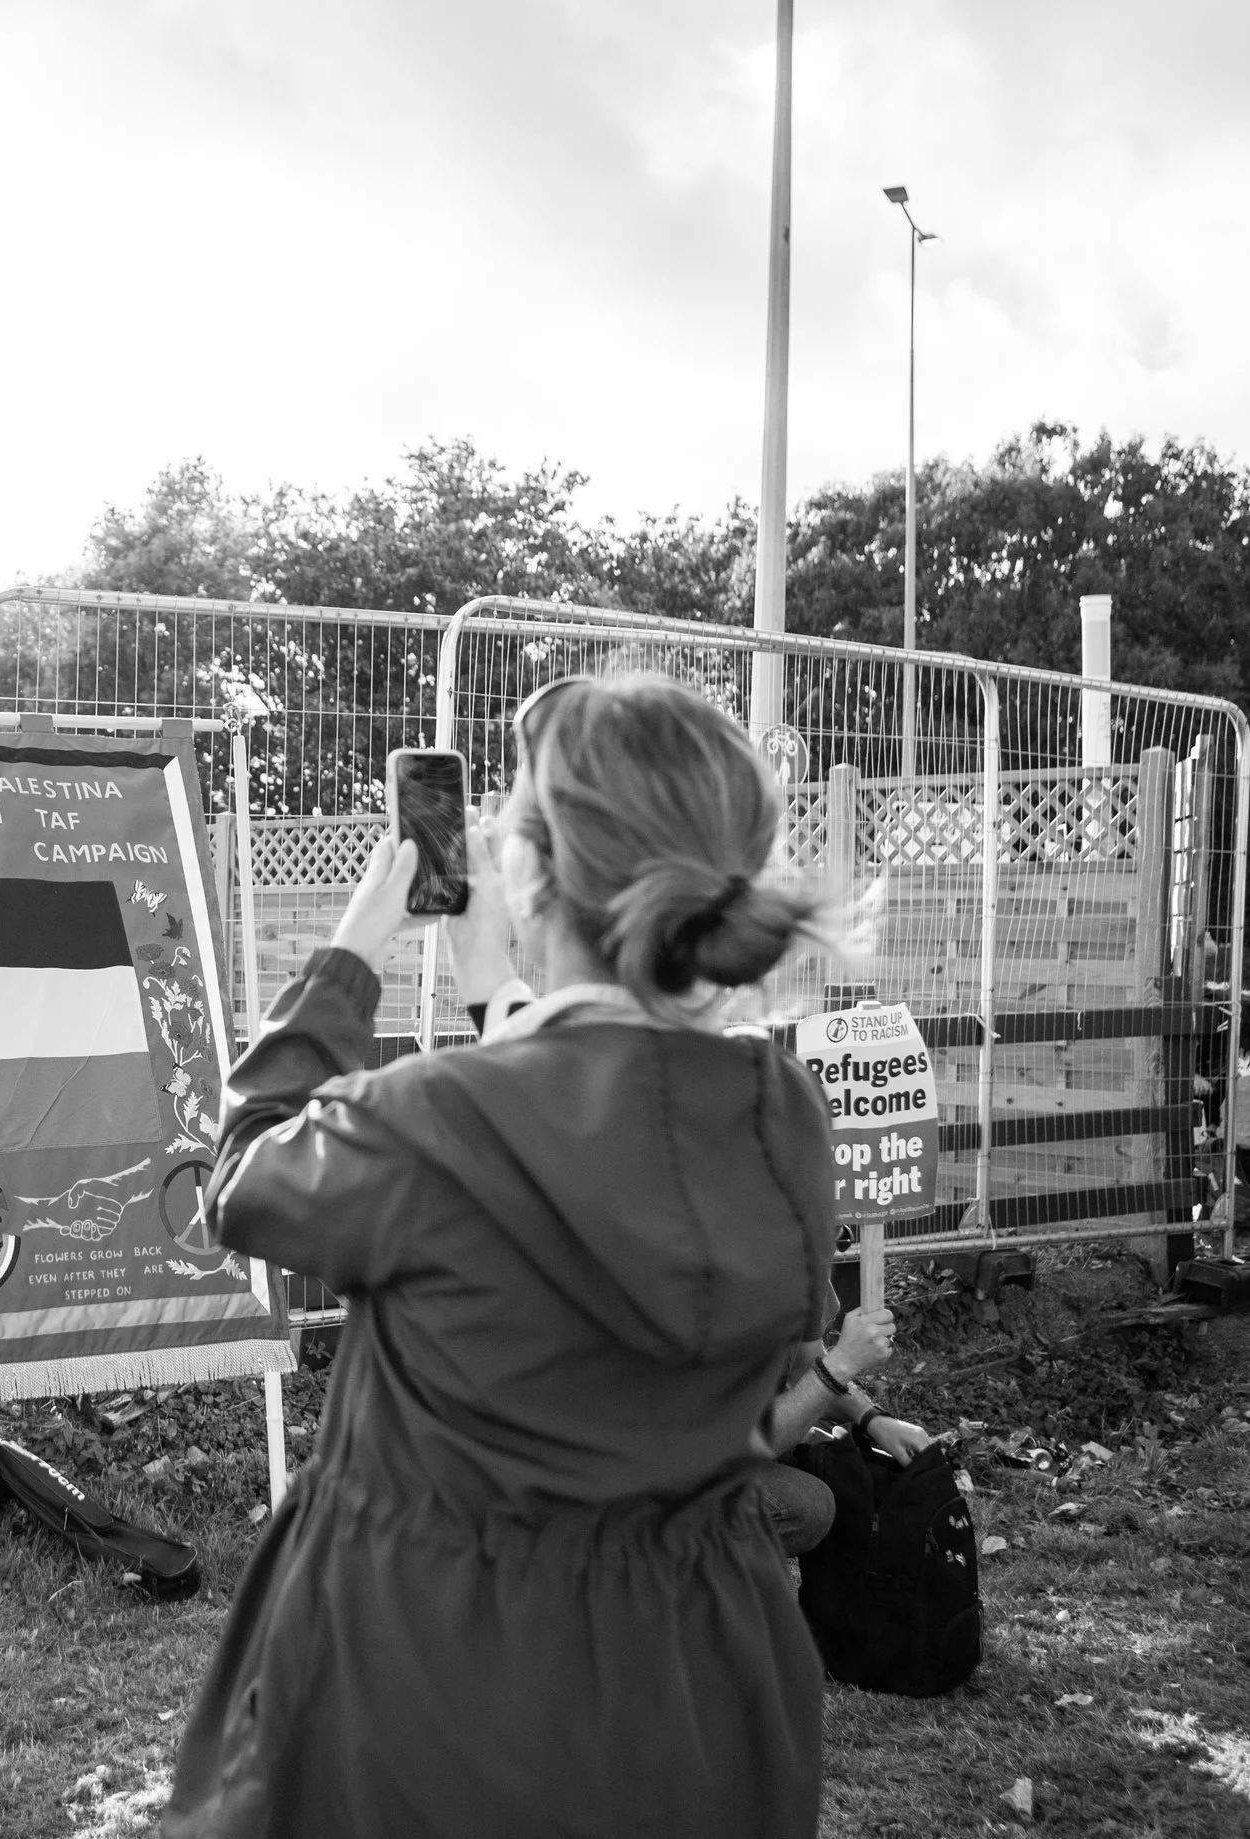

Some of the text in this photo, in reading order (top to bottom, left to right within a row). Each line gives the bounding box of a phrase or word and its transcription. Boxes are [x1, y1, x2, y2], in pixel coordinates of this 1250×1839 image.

[34, 808, 80, 830] TAF
[33, 842, 168, 864] CAMPAIGN
[851, 1012, 903, 1028] STAND UP
[852, 1024, 909, 1042] TO RACISM
[806, 1051, 928, 1088] Refugees
[829, 1088, 926, 1118] elcome
[880, 1132, 923, 1163] the
[854, 1165, 922, 1206] right
[35, 1246, 162, 1264] FLOWERS GROW BACK
[28, 1264, 164, 1285] EVEN AFTER THEY ARE
[65, 1286, 132, 1300] STEPPED ON
